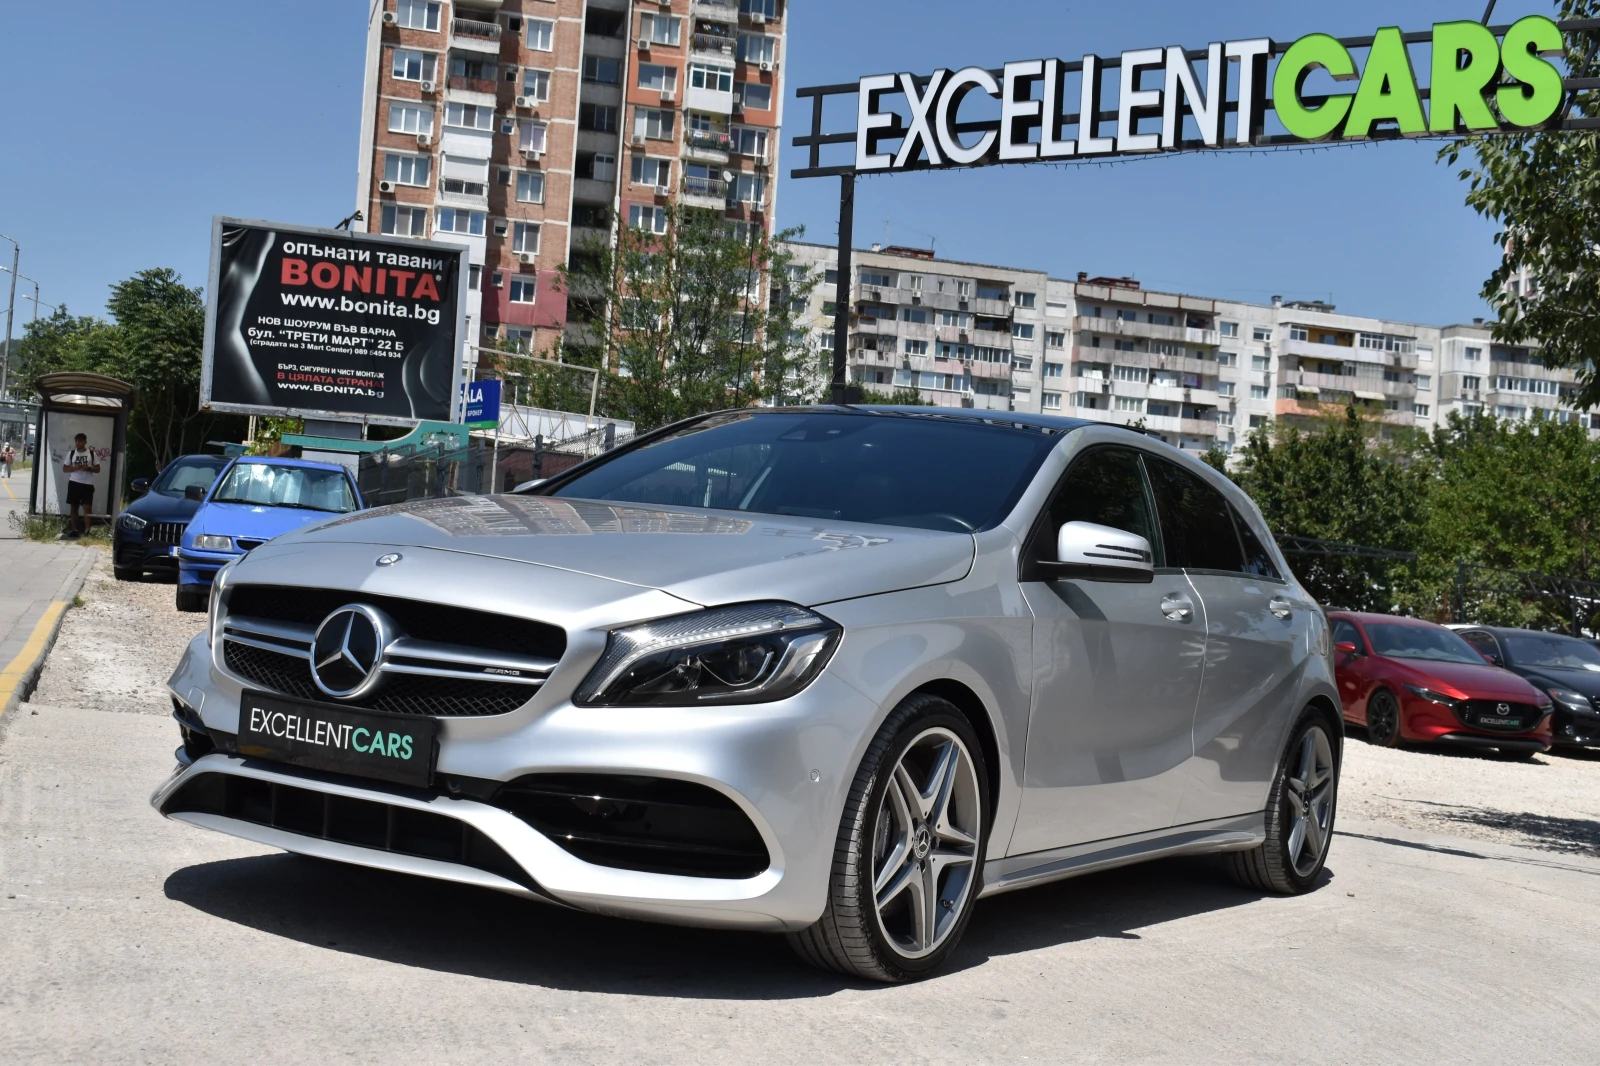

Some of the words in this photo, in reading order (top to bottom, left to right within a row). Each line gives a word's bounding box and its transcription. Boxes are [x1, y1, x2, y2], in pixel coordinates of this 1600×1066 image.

[855, 14, 1565, 170] EXCELLENTCARS
[283, 241, 371, 262] опънати
[376, 251, 443, 271] тавани
[281, 293, 440, 325] www.bonita.bg
[258, 316, 281, 325] НОВ
[284, 318, 331, 331] ШОУРУМ
[334, 323, 358, 333] ВЪВ
[360, 326, 396, 337] ВАРНА
[248, 327, 275, 339] бул.
[377, 340, 392, 350] 22
[395, 341, 404, 351] Б
[250, 338, 287, 349] (сградата
[306, 343, 324, 351] Mart
[326, 345, 353, 355] Center)
[354, 347, 368, 355] 089
[277, 372, 285, 380] В
[288, 373, 334, 384] ЦЯЛАТА
[299, 365, 330, 374] СИГУРЕН
[356, 371, 385, 379] МОНТАЖ
[277, 382, 385, 399] www.BONITA.bg
[249, 707, 414, 760] EXCELLENTCARS
